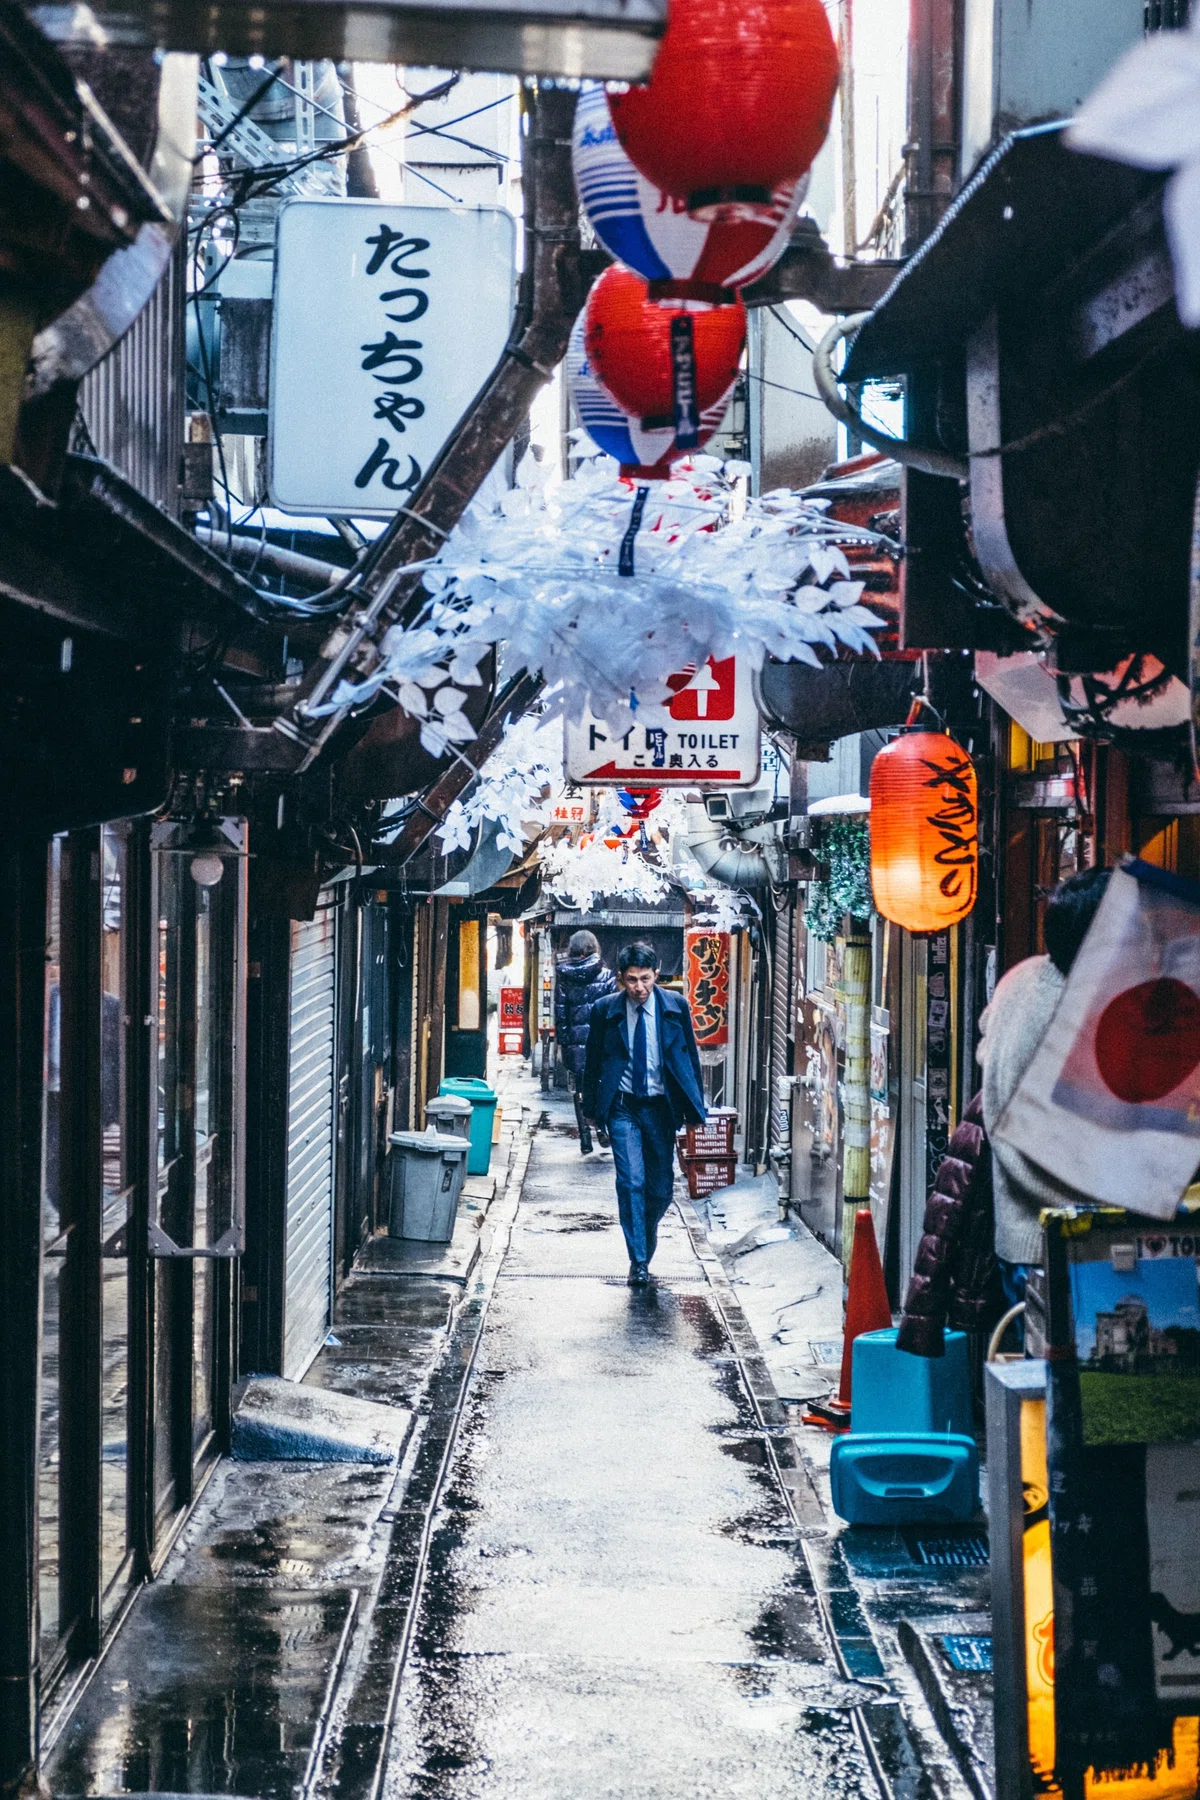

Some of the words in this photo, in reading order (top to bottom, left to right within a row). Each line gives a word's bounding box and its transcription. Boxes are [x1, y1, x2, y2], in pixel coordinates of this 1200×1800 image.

[355, 223, 431, 493] たっちゃん
[677, 733, 740, 749] TOILET
[550, 806, 584, 822] 桂冠
